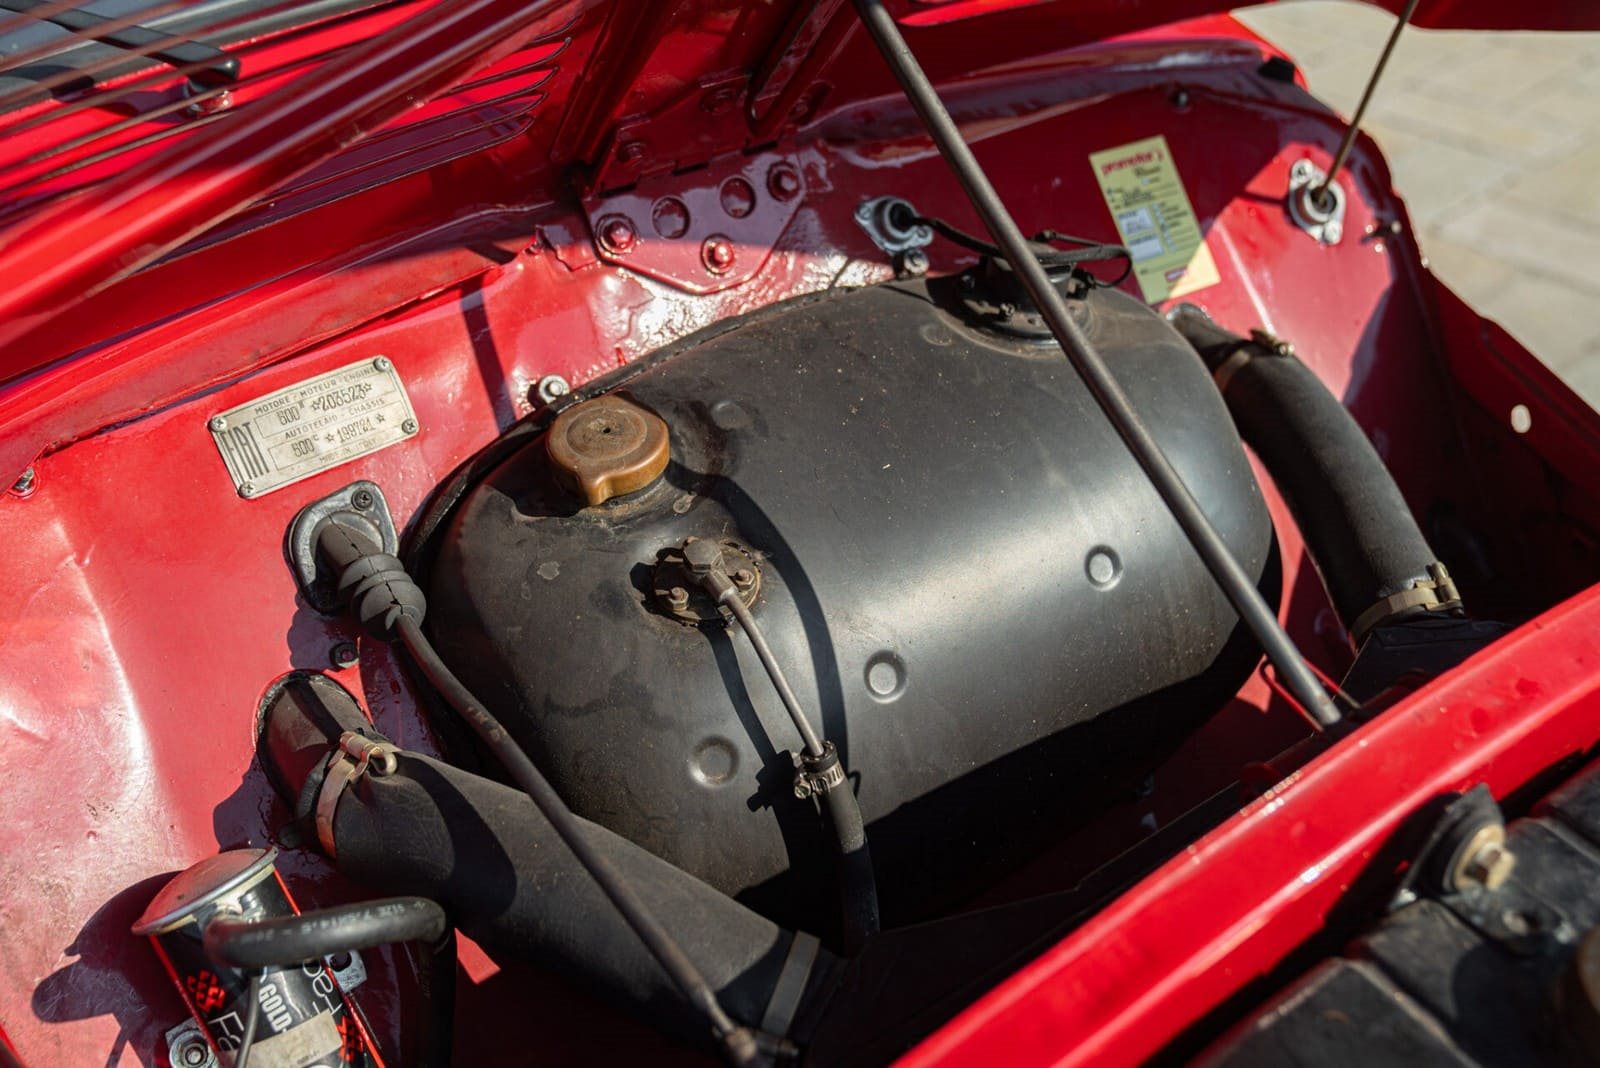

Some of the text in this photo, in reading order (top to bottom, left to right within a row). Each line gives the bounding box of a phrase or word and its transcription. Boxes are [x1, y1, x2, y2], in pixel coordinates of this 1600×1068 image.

[254, 396, 290, 414] MOTORE
[299, 380, 337, 397] MOTEUR
[349, 398, 385, 415] CHASSIS
[219, 422, 270, 482] FIAT
